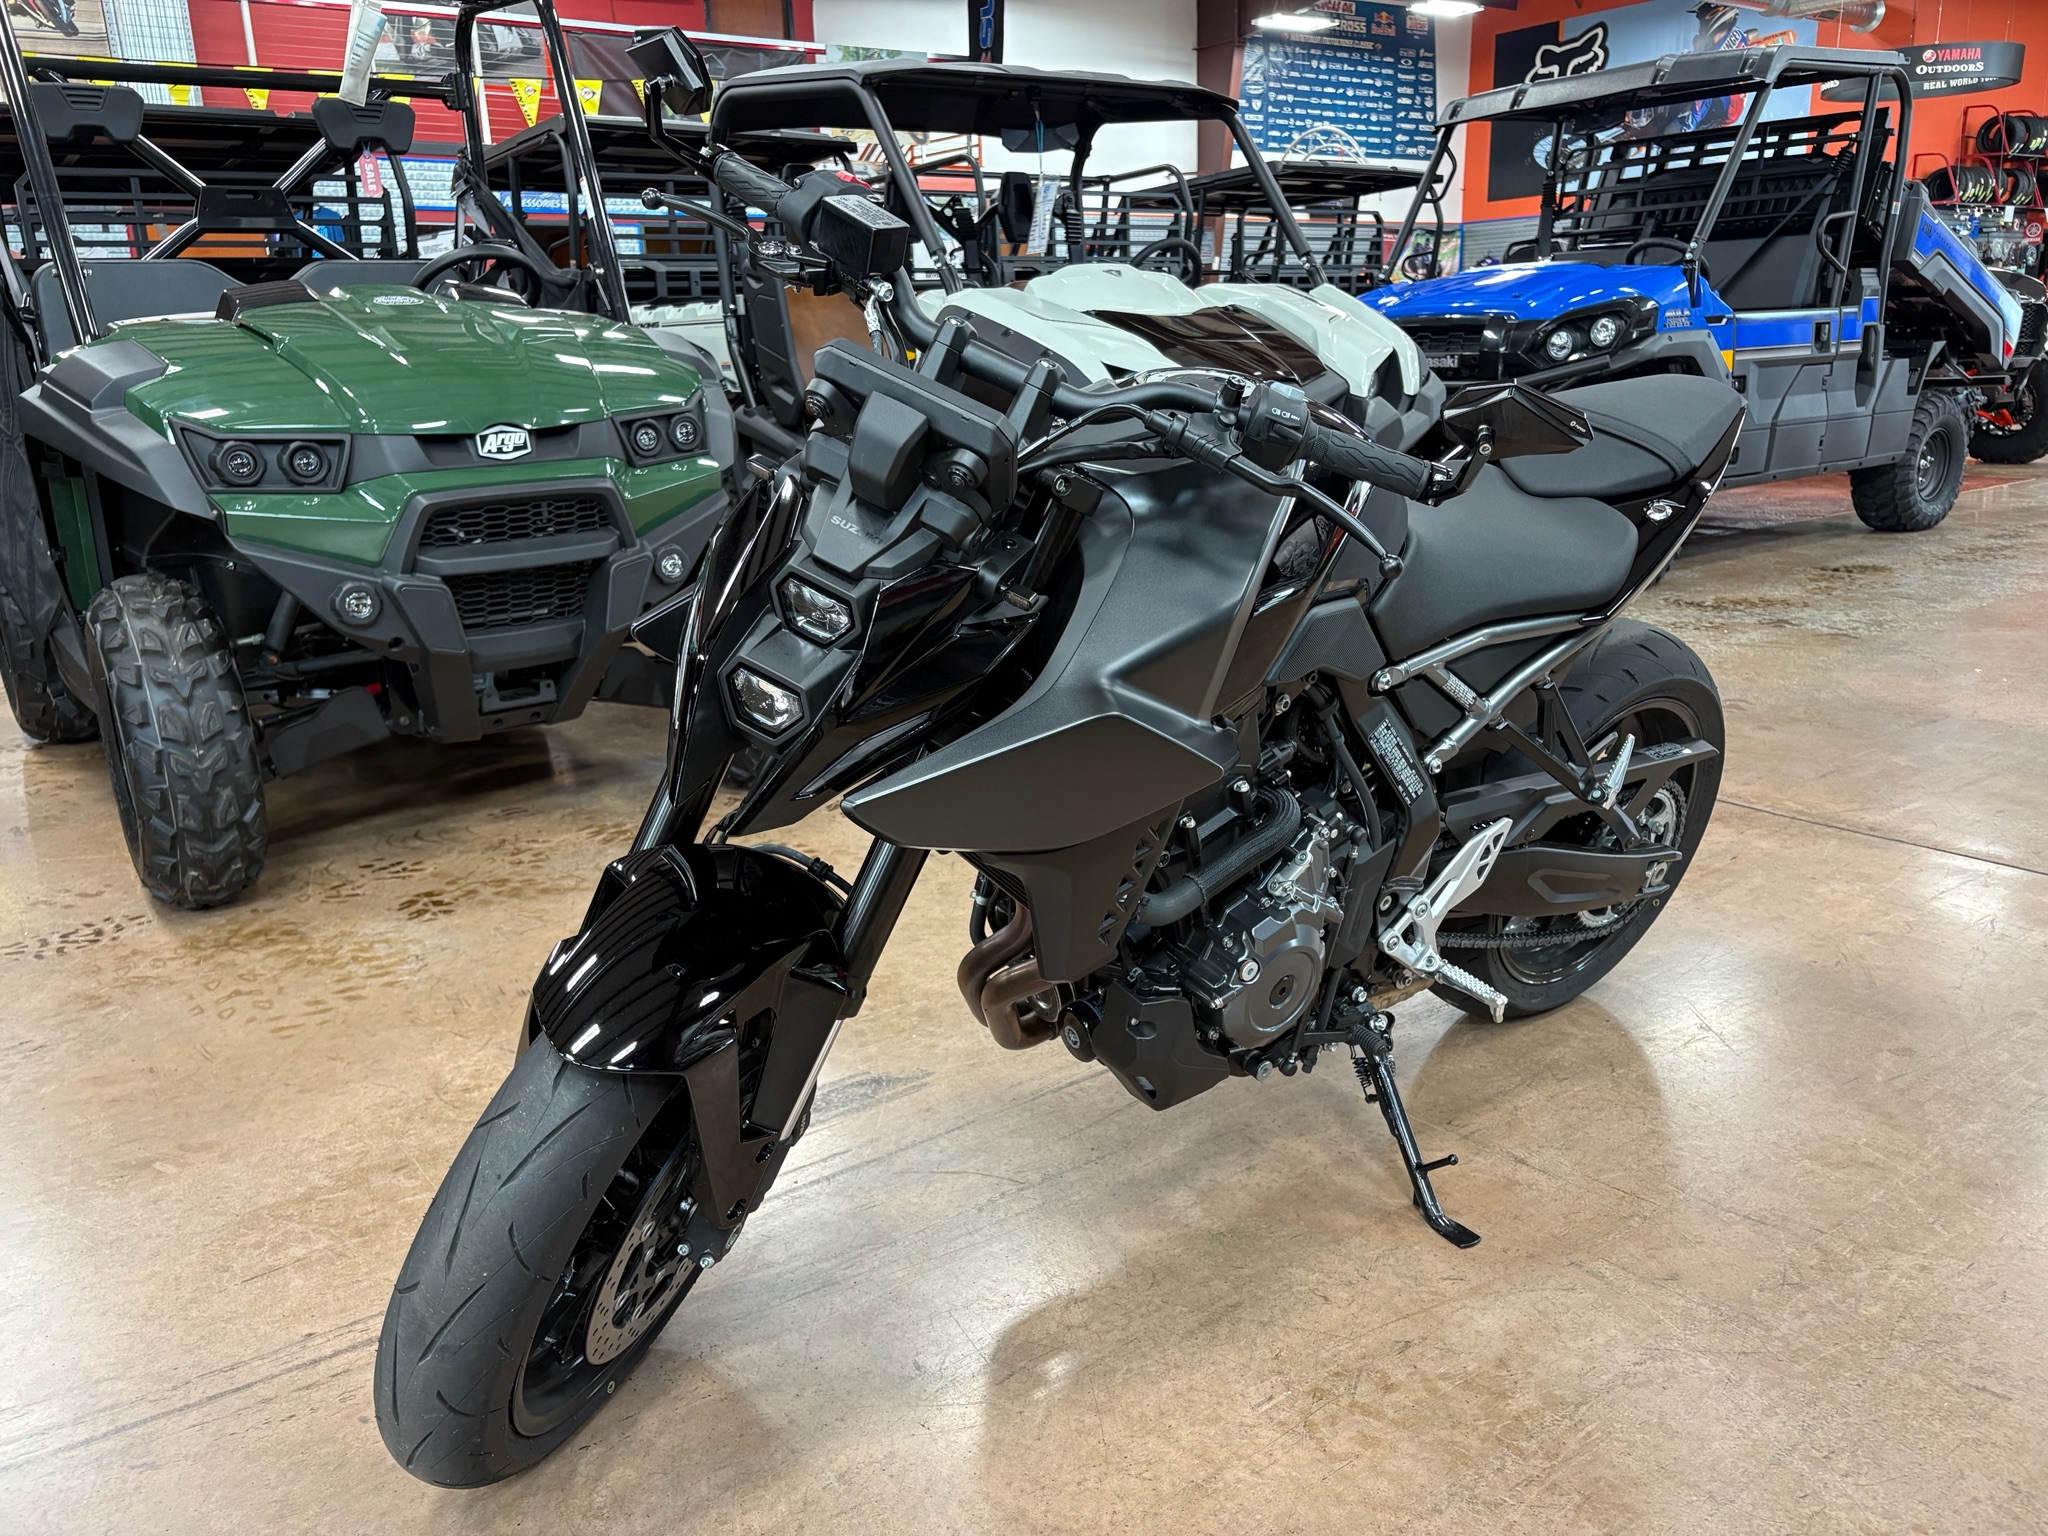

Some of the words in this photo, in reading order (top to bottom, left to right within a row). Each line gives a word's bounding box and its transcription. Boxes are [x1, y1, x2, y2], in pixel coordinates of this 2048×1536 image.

[1937, 48, 1981, 61] YAMAHA
[1820, 79, 1840, 92] DOORS
[1923, 79, 1947, 90] REAL
[1949, 77, 1978, 88] WORLD
[365, 163, 377, 191] SALE
[503, 196, 561, 209] AESSORIES
[1427, 355, 1459, 368] asaki
[483, 432, 526, 453] Argo
